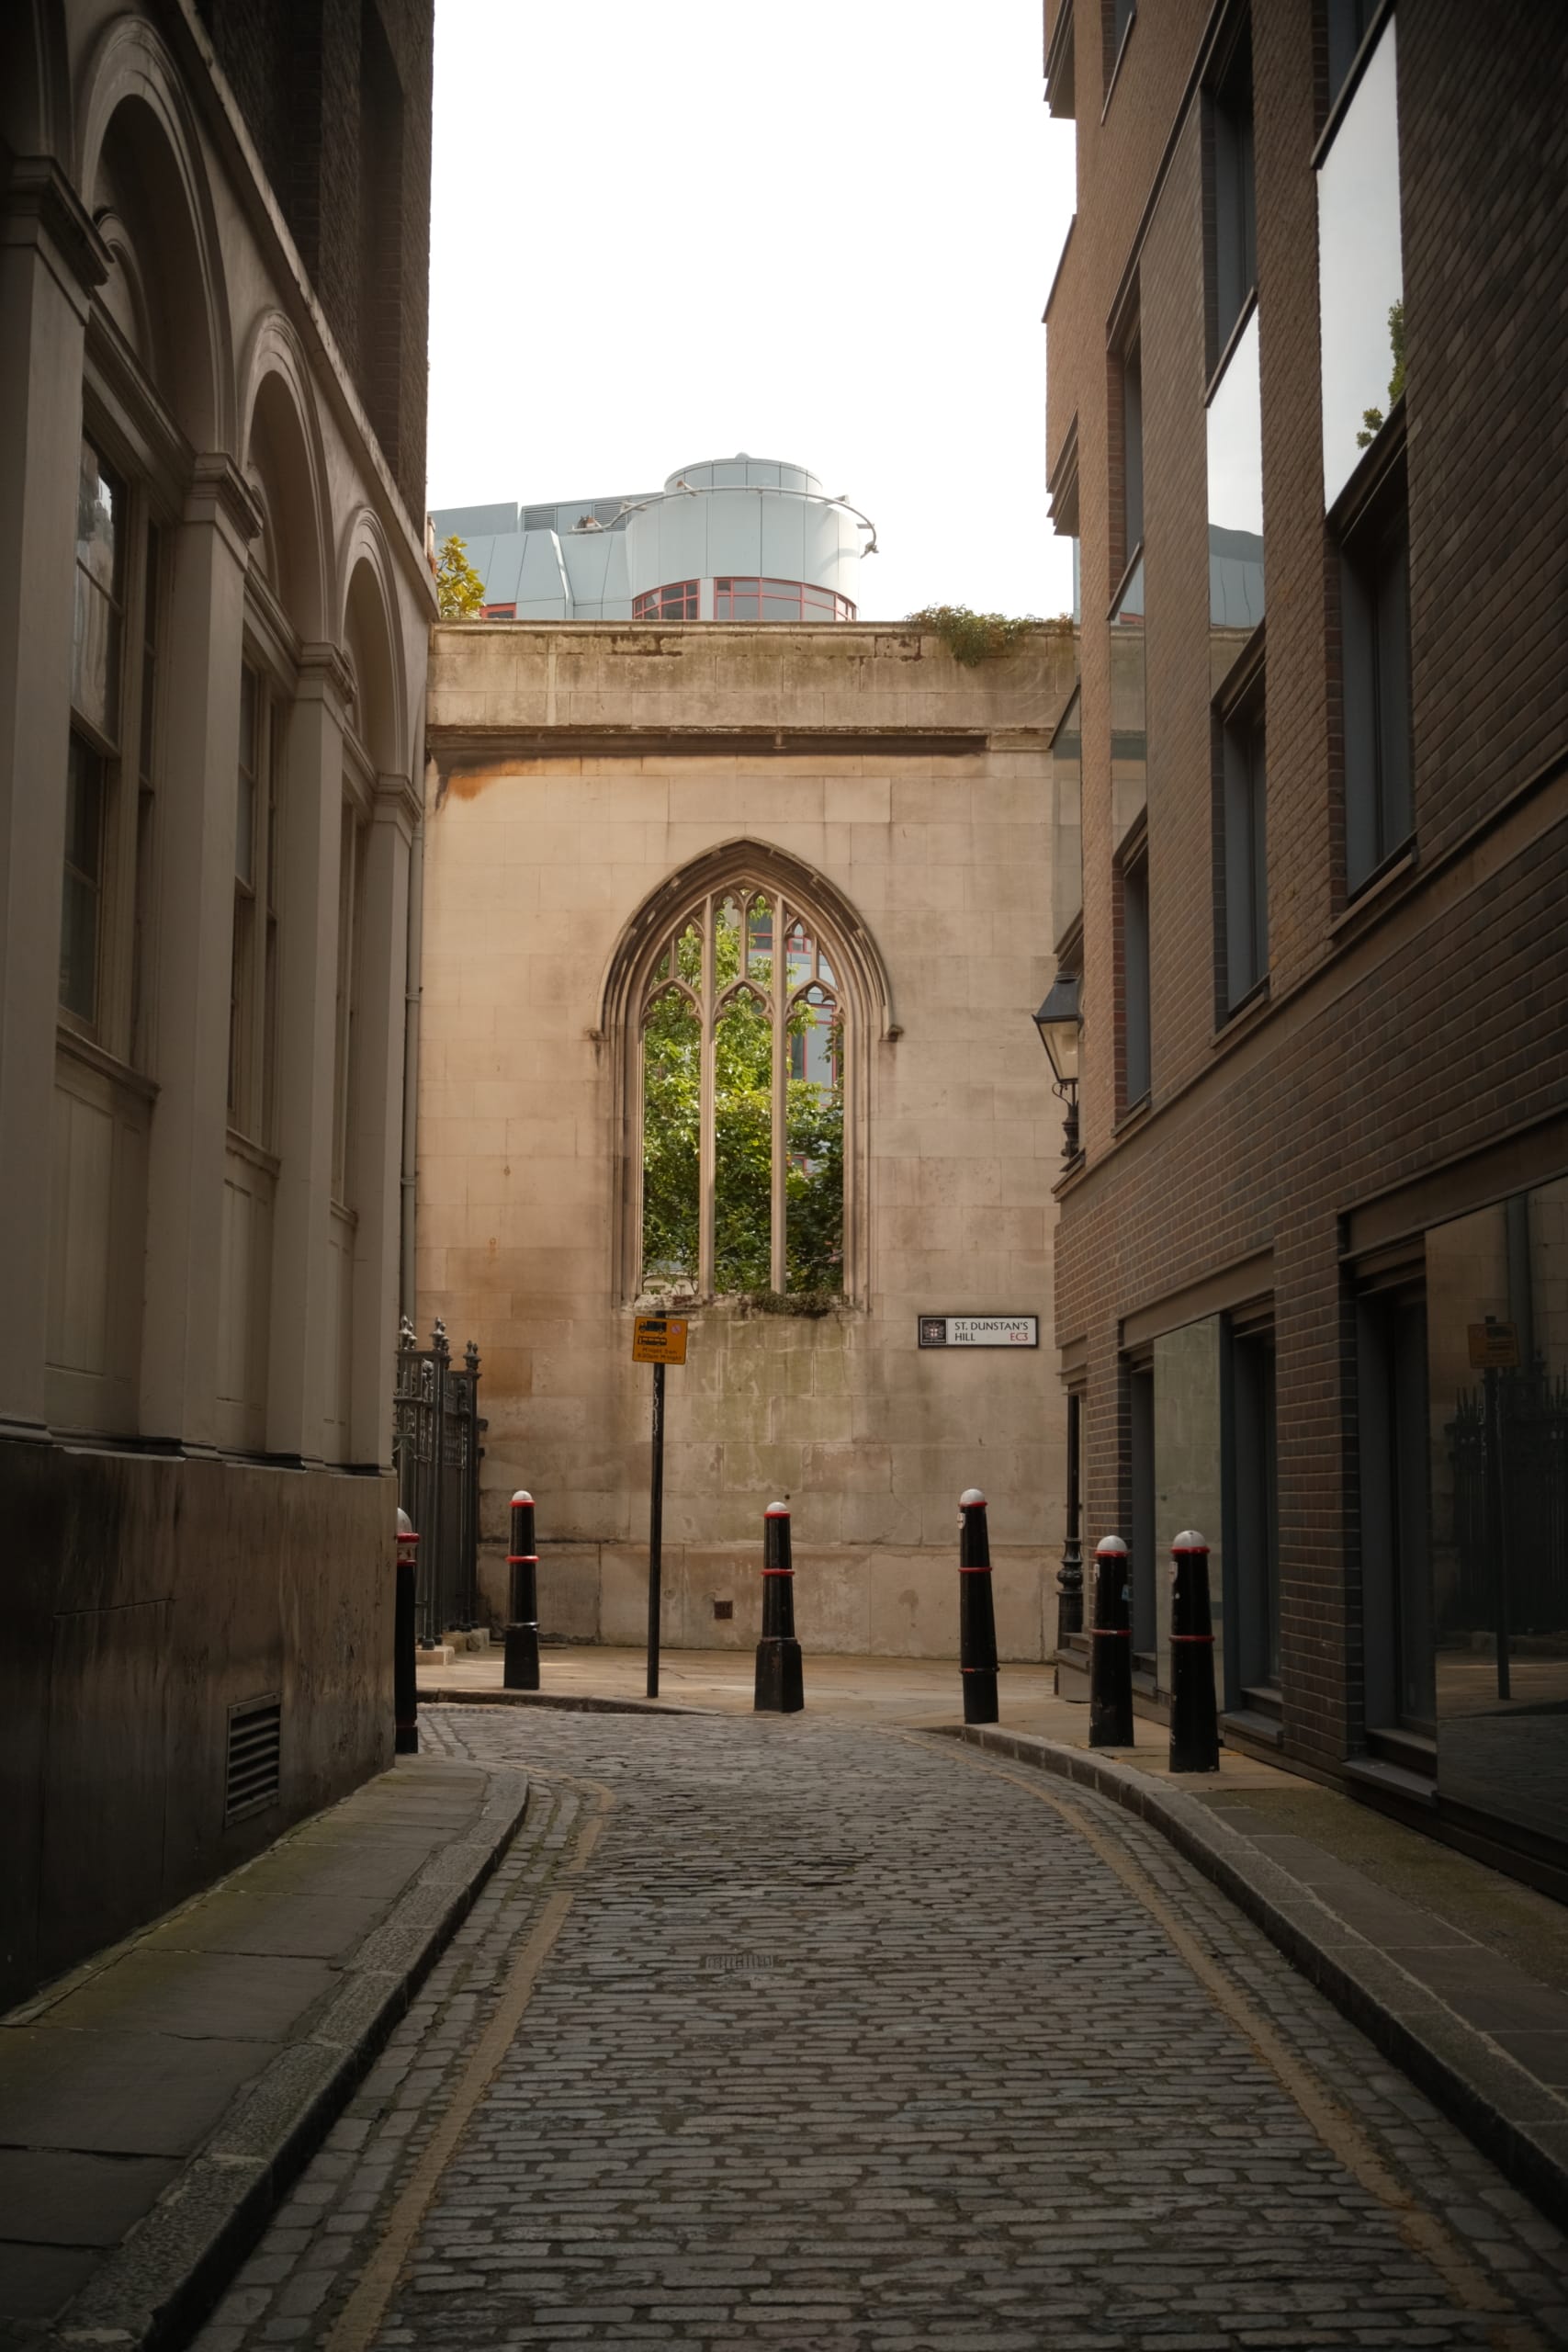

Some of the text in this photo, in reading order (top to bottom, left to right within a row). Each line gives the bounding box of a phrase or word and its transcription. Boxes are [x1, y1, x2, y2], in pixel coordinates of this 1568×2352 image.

[954, 1322, 1029, 1330] ST. DUNSTAN'S
[954, 1332, 1029, 1341] HILL EC3
